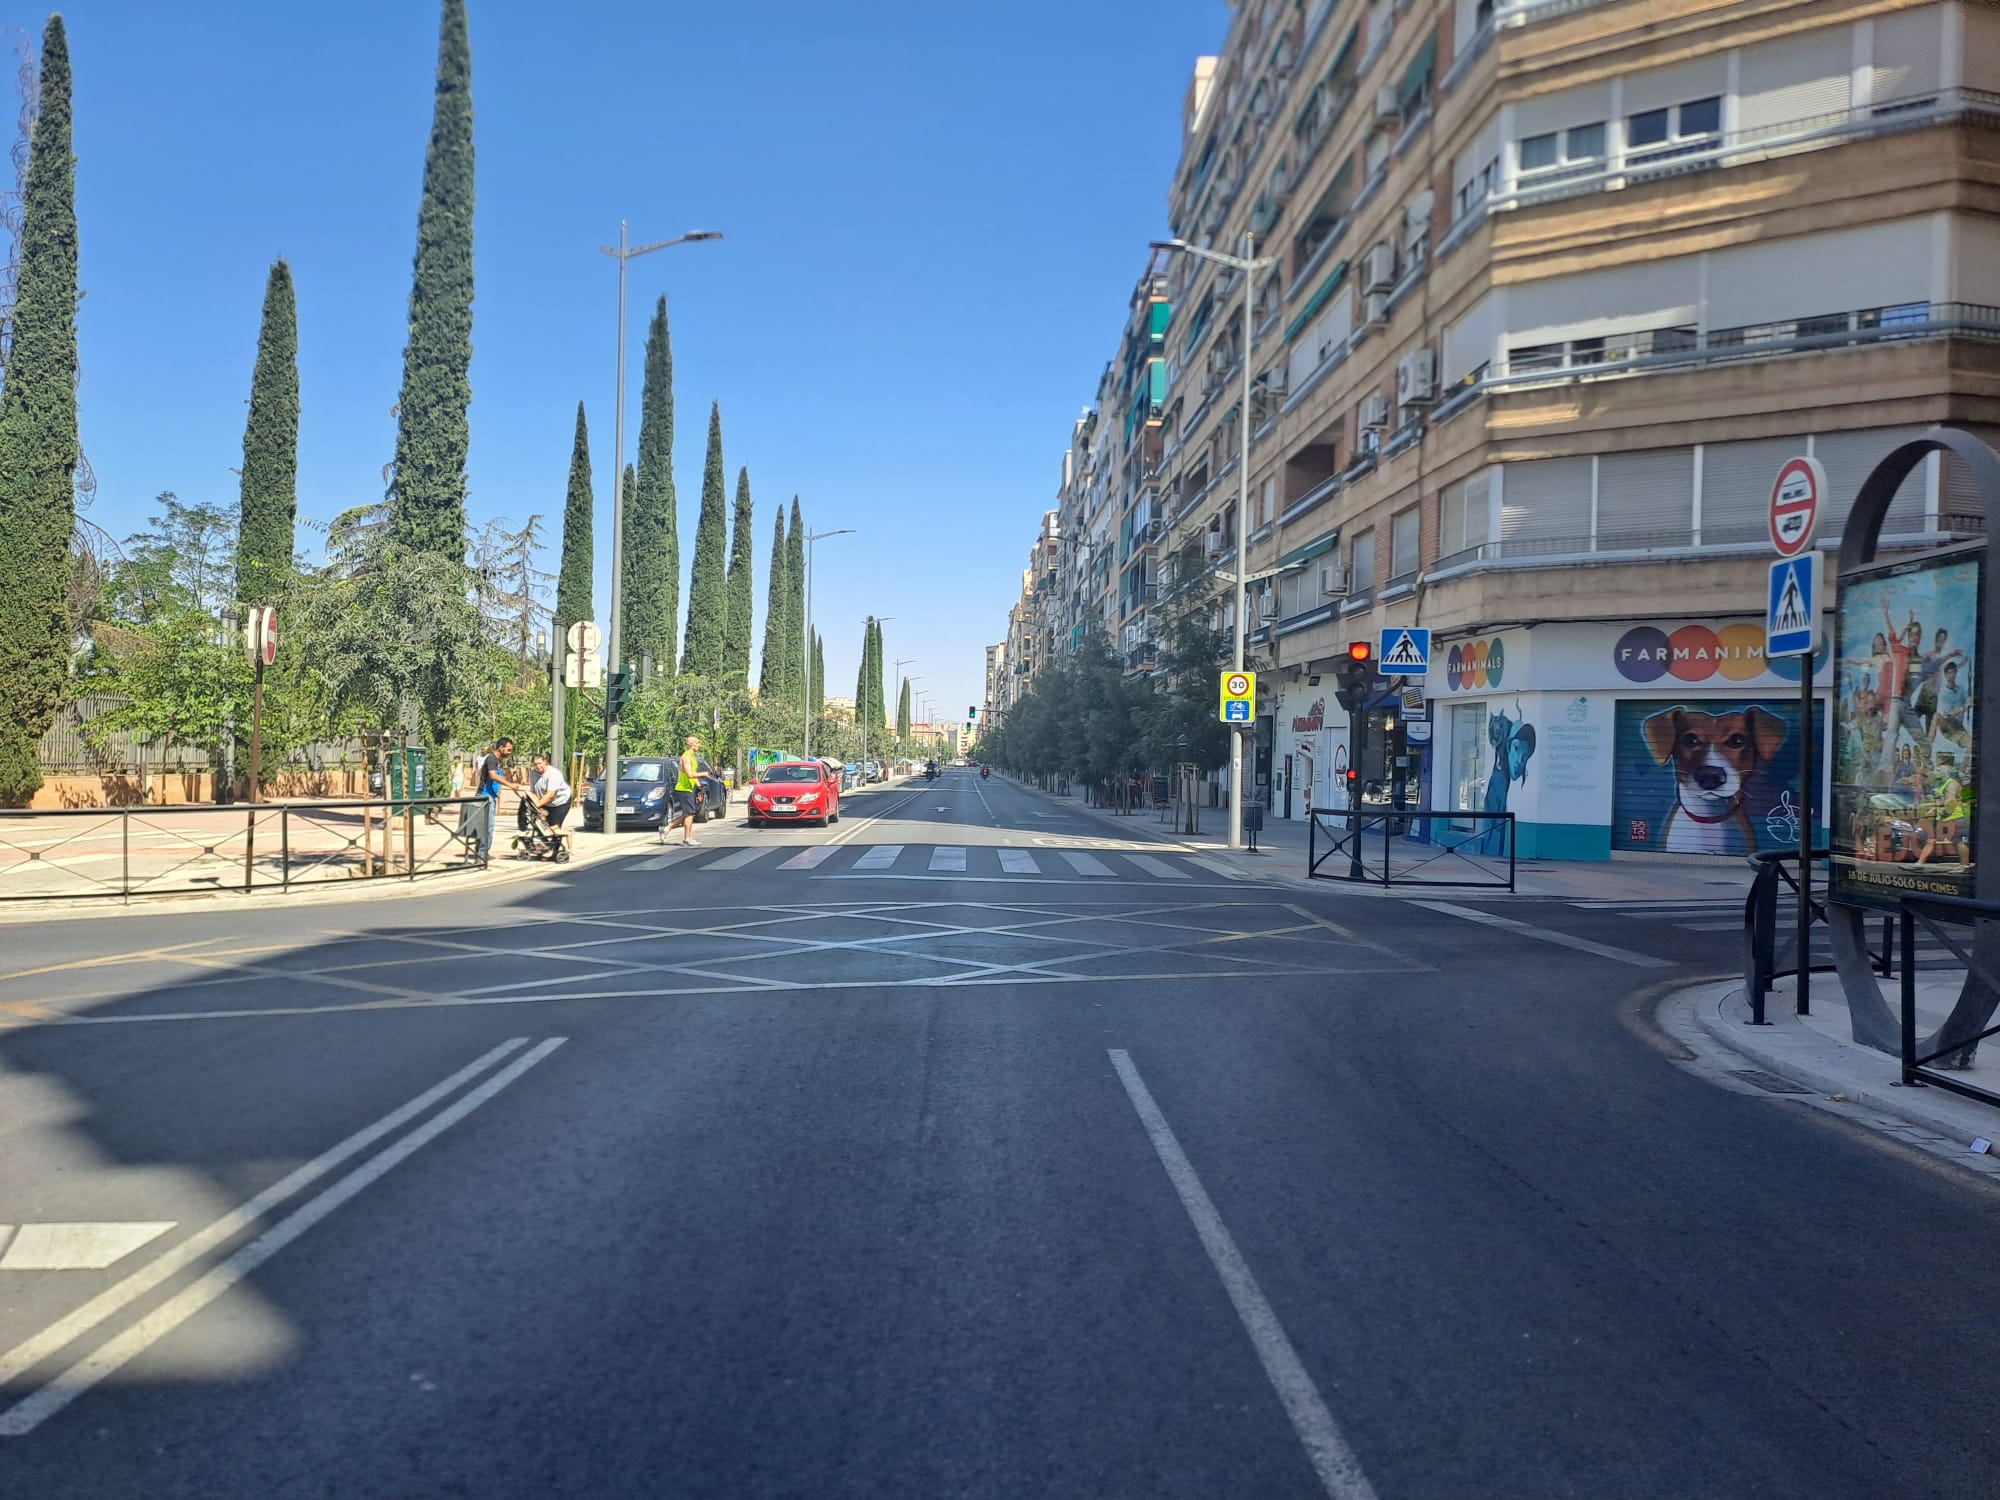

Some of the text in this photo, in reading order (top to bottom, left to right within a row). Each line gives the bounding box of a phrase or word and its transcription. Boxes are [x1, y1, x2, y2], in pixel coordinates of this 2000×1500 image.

[1621, 645, 1820, 662] FARMANIM
[1448, 656, 1502, 673] FARMANIMALS
[1231, 681, 1245, 689] 30
[1857, 871, 1868, 882] DE
[1869, 873, 1892, 886] JULIO
[1893, 876, 1916, 889] SOLO
[1917, 880, 1929, 892] EN
[1930, 882, 1959, 896] CINES
